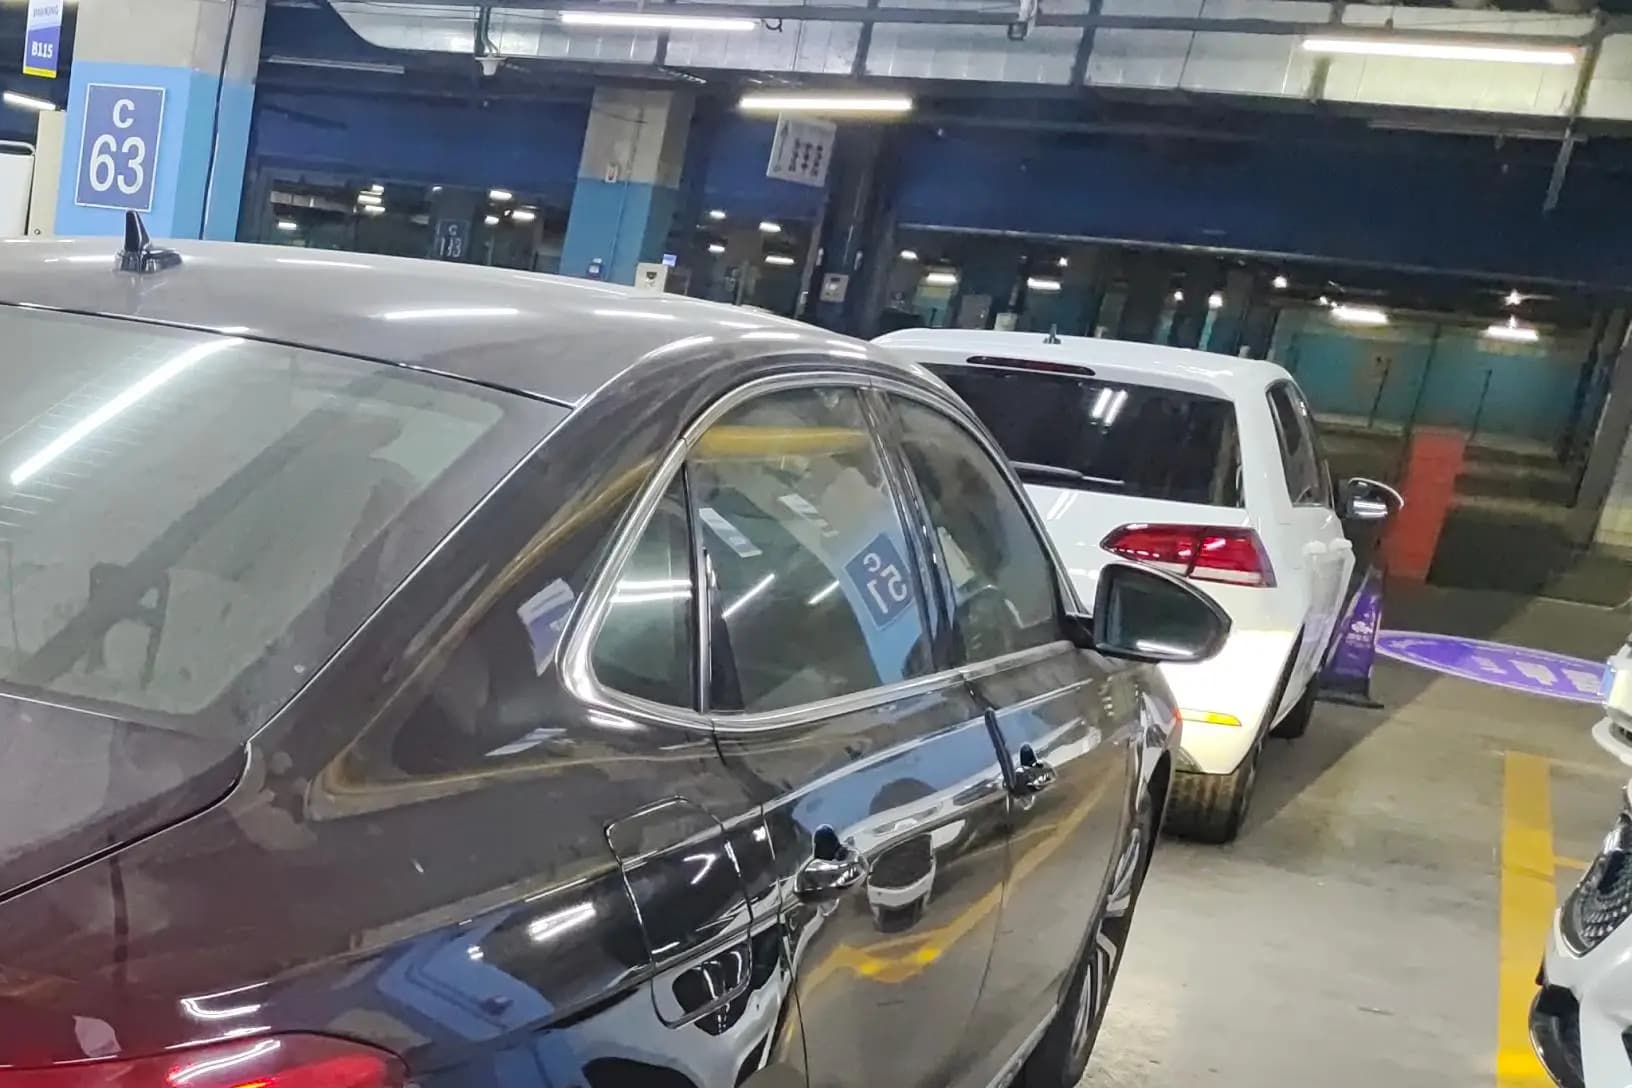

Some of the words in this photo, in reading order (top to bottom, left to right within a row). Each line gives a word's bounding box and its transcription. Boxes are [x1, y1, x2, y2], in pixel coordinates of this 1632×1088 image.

[31, 41, 54, 58] B115
[112, 99, 136, 128] C
[89, 134, 146, 195] 63
